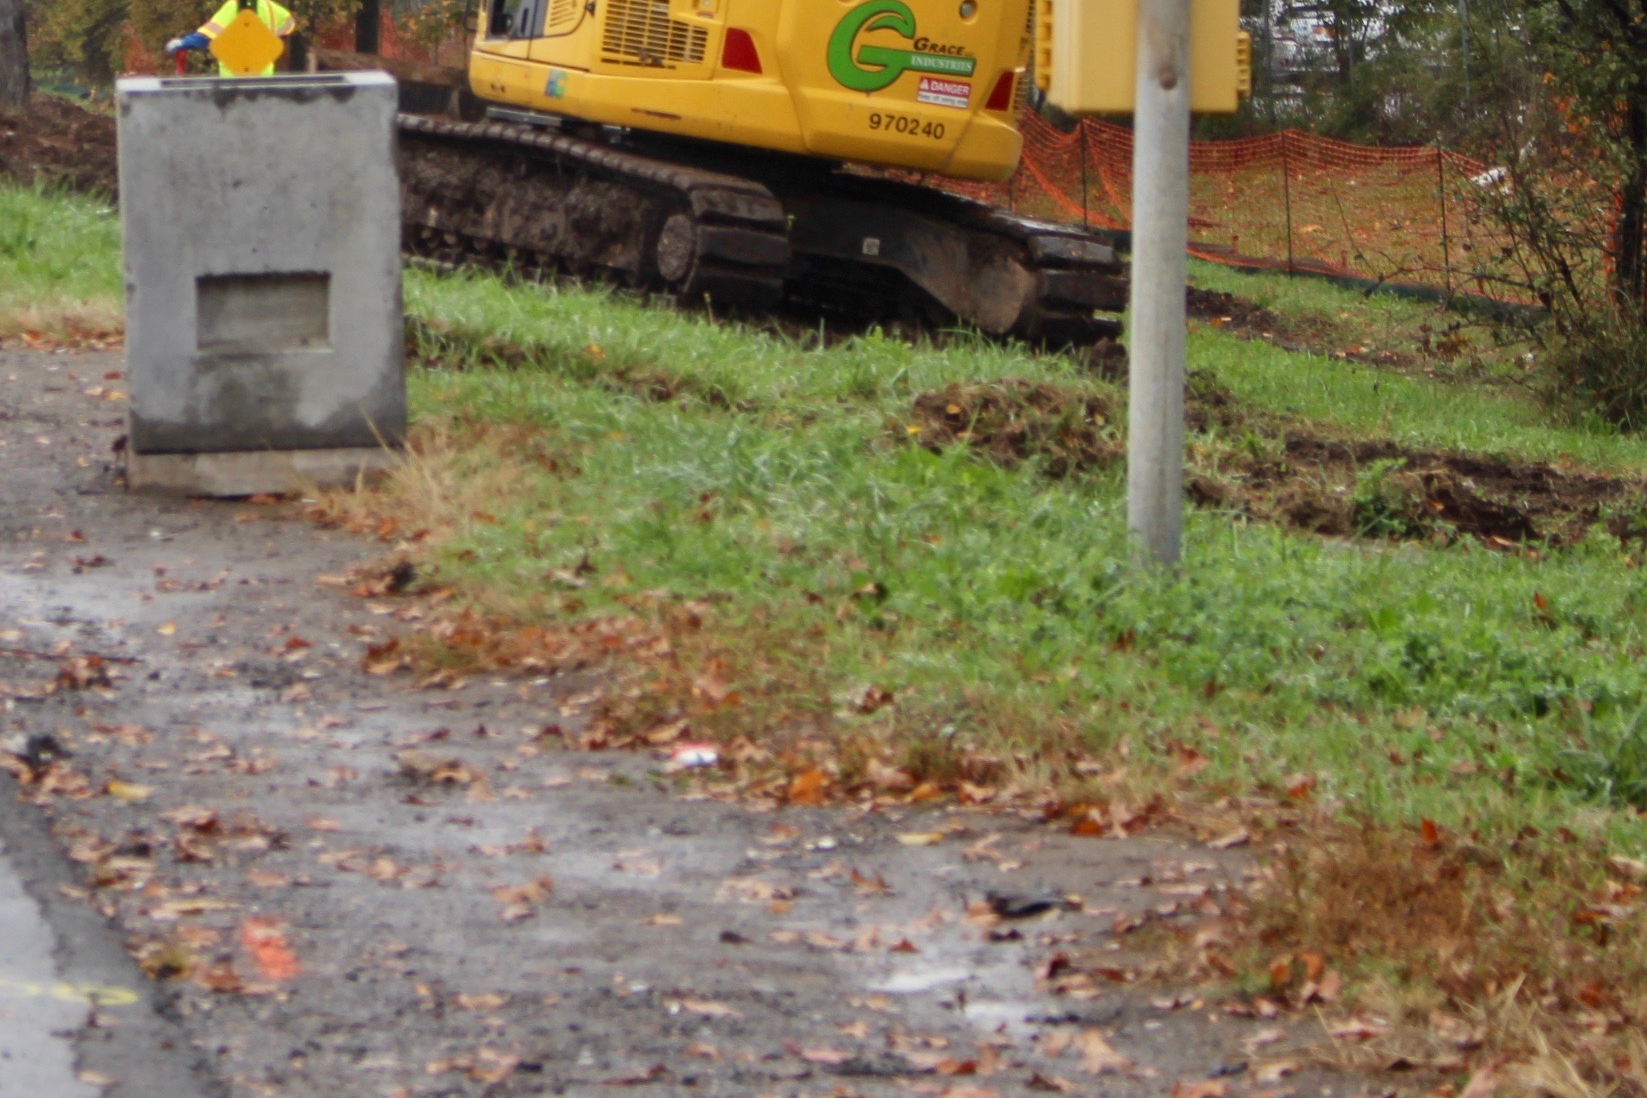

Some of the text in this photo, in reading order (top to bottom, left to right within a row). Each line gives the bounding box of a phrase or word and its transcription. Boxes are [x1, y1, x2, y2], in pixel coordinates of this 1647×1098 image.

[913, 37, 965, 56] GRACE
[911, 54, 972, 72] INDUSTRIES
[930, 80, 969, 96] DANGER
[868, 113, 945, 140] 970240
